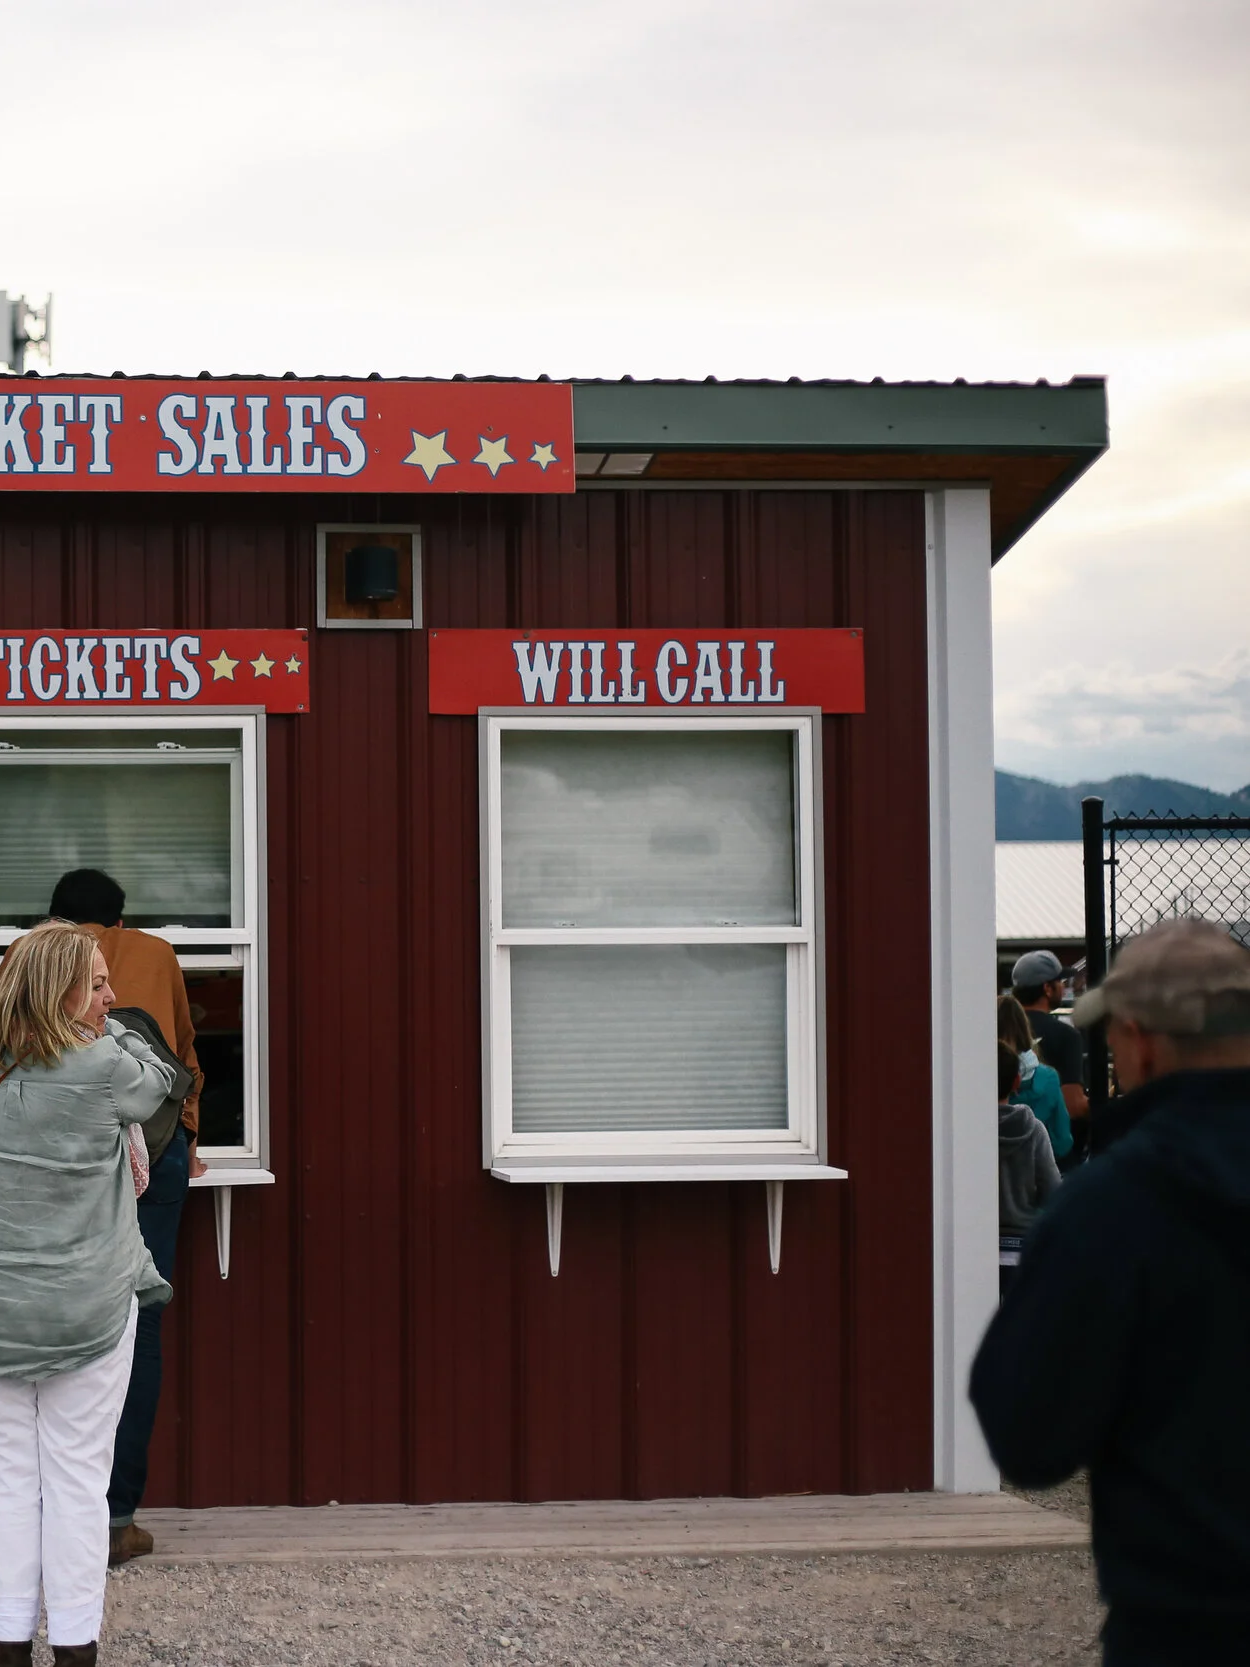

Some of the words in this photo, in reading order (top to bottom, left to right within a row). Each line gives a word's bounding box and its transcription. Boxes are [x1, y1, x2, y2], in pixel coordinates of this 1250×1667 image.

[156, 393, 369, 478] SALES
[512, 641, 646, 703] WILL
[654, 640, 785, 703] CALL
